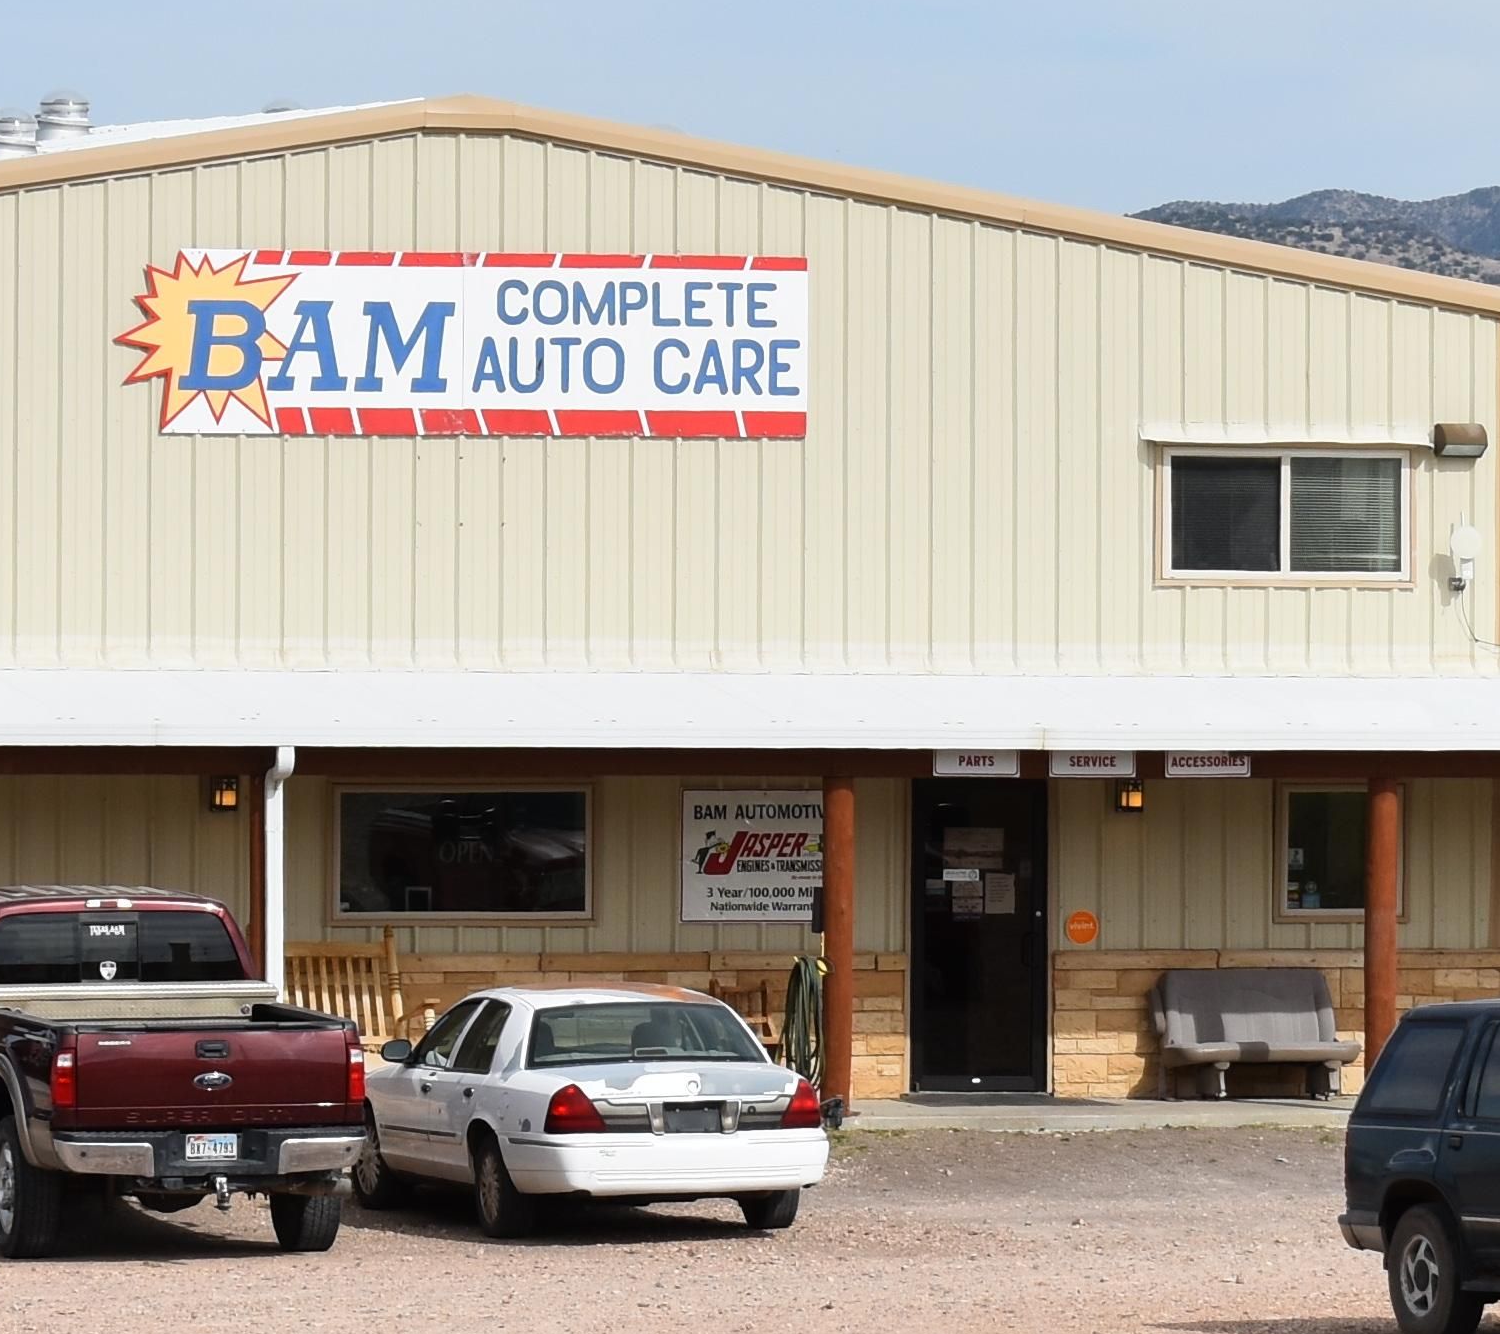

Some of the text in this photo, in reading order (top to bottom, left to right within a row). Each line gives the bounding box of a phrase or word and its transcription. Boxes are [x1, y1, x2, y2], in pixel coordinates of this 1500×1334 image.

[497, 279, 779, 329] COMPLETE
[178, 300, 456, 392] BAM
[472, 337, 802, 397] AUTO CARE
[958, 755, 995, 767] PARTS
[1069, 756, 1117, 768] SERVICE
[1171, 755, 1246, 768] ACCESSORIES
[693, 803, 823, 820] BAM AUTOMOTIV
[439, 841, 493, 863] OPEN
[703, 830, 809, 876] JASPER
[736, 859, 770, 873] ENGINES
[776, 859, 823, 873] TRANSMISS
[707, 887, 714, 898] 3
[717, 887, 795, 899] Year/100,000
[710, 901, 814, 912] Nationwide Warrant
[126, 1110, 212, 1123] SUPER
